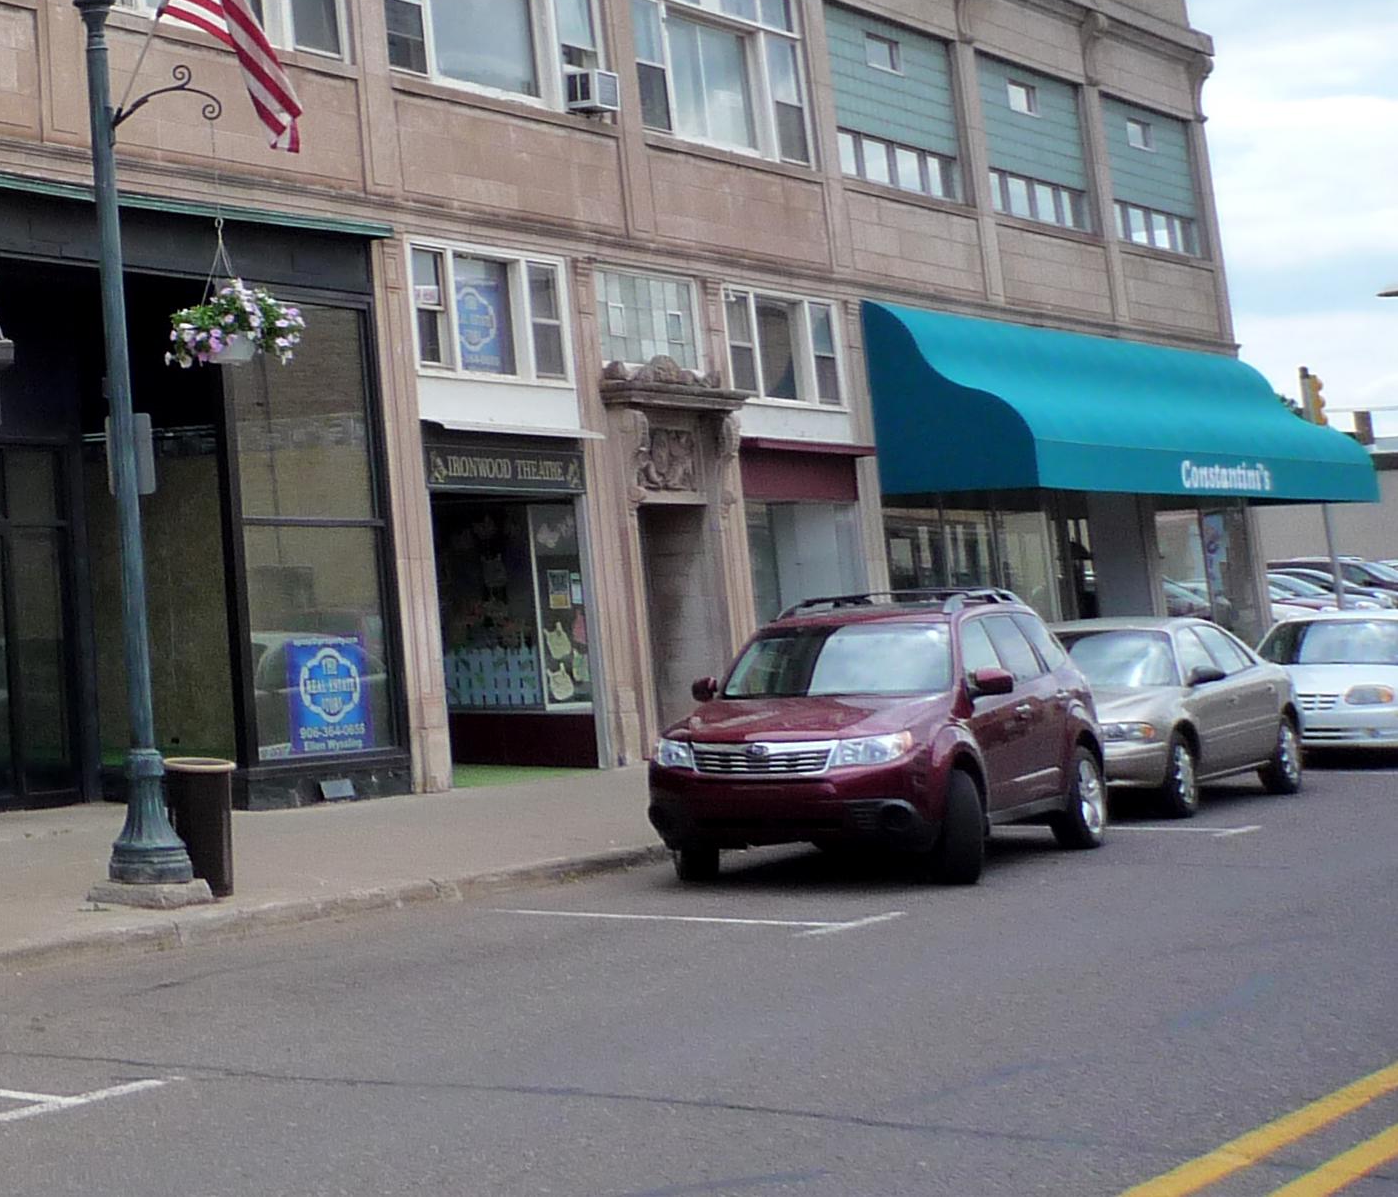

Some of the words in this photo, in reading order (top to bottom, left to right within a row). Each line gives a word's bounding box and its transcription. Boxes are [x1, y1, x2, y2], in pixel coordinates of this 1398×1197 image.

[447, 456, 512, 479] IRONWOOD
[514, 457, 566, 482] THEATRE
[1181, 460, 1271, 491] Constantini's
